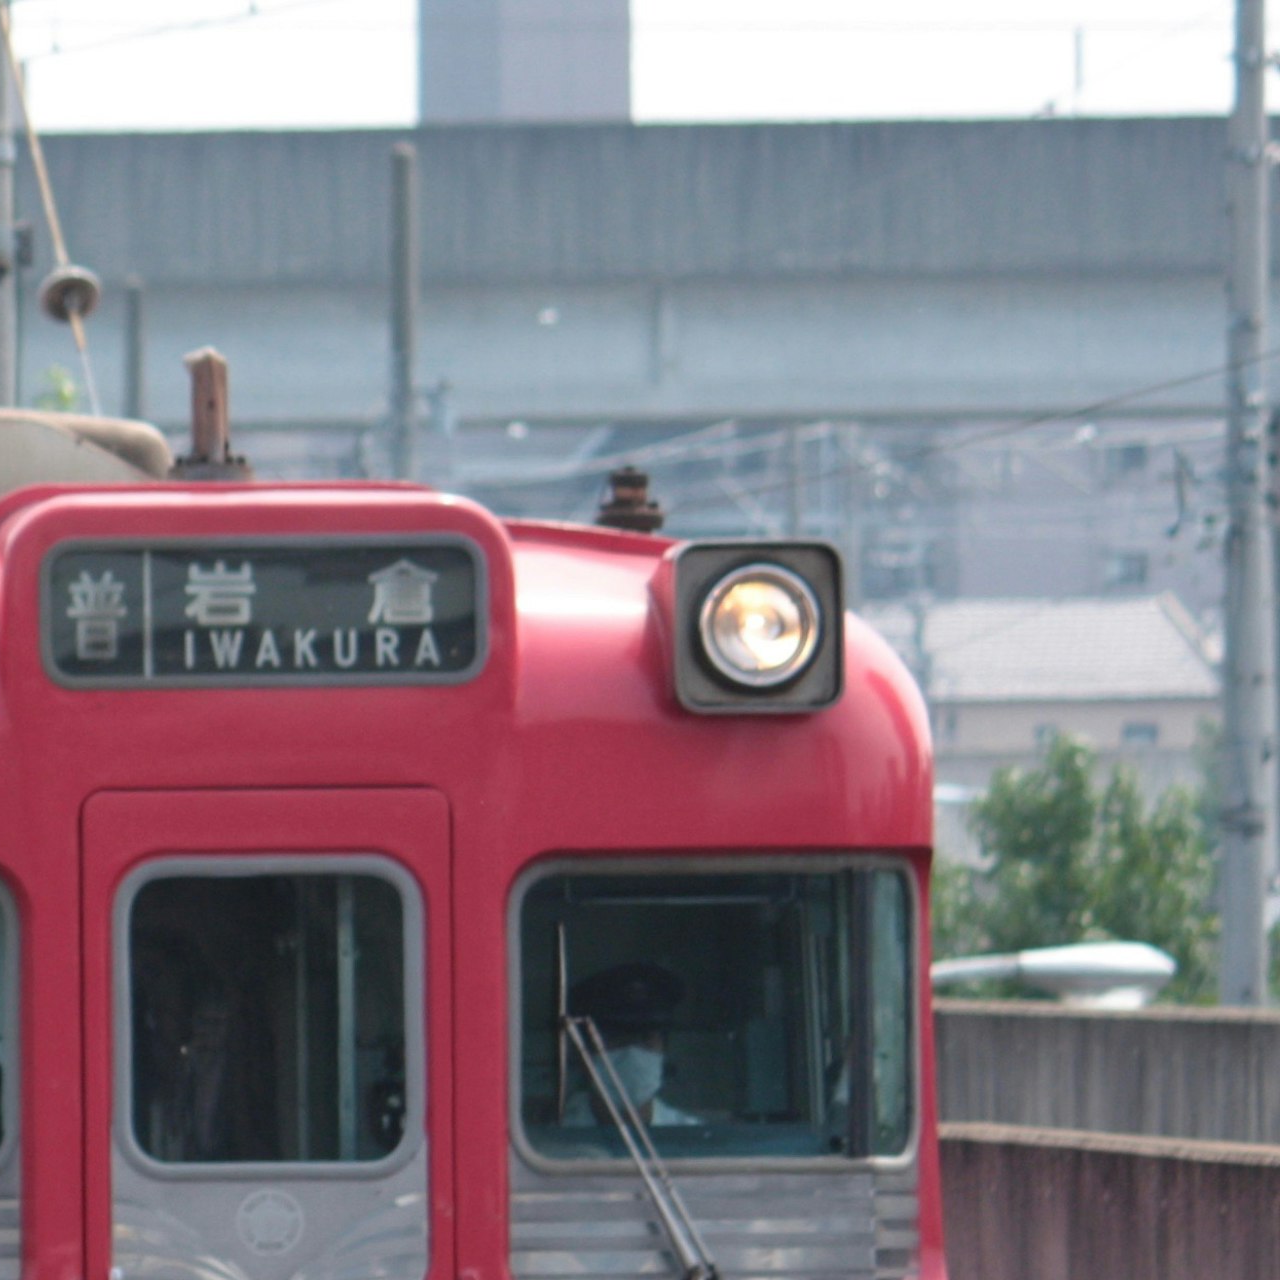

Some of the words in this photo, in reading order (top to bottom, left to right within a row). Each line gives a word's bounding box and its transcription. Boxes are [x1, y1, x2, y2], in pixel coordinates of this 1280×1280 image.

[67, 570, 127, 660] 普
[185, 558, 438, 627] 岩倉
[185, 629, 440, 669] IWAKURA
